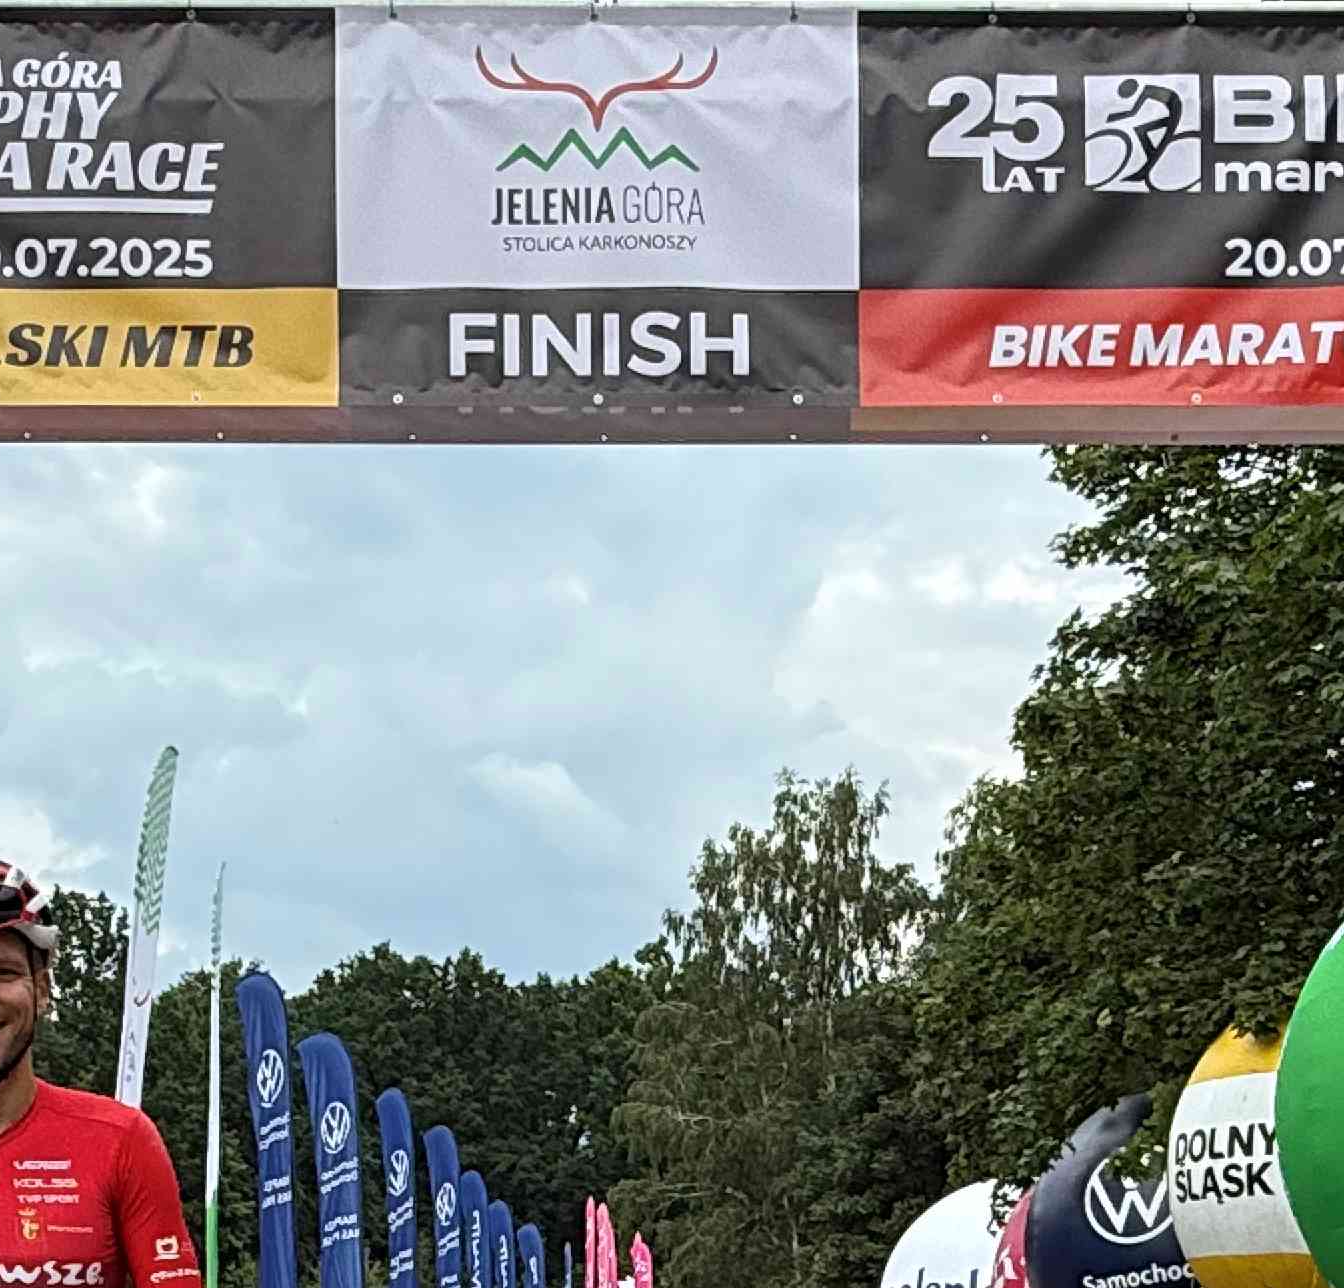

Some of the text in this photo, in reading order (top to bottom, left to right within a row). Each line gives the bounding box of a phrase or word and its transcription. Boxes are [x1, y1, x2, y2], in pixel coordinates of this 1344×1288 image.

[12, 52, 122, 89] GÓRA
[928, 74, 1065, 162] 25
[47, 142, 225, 192] RACE
[491, 181, 705, 226] JELENIA GÓRA
[503, 234, 698, 253] STOLICA KARKONOSZY
[119, 324, 255, 369] MTB
[448, 312, 750, 377] FINISH
[989, 324, 1122, 368] BIKE
[1175, 1122, 1276, 1167] DOLNY
[1175, 1160, 1275, 1205] ŚLĄSK
